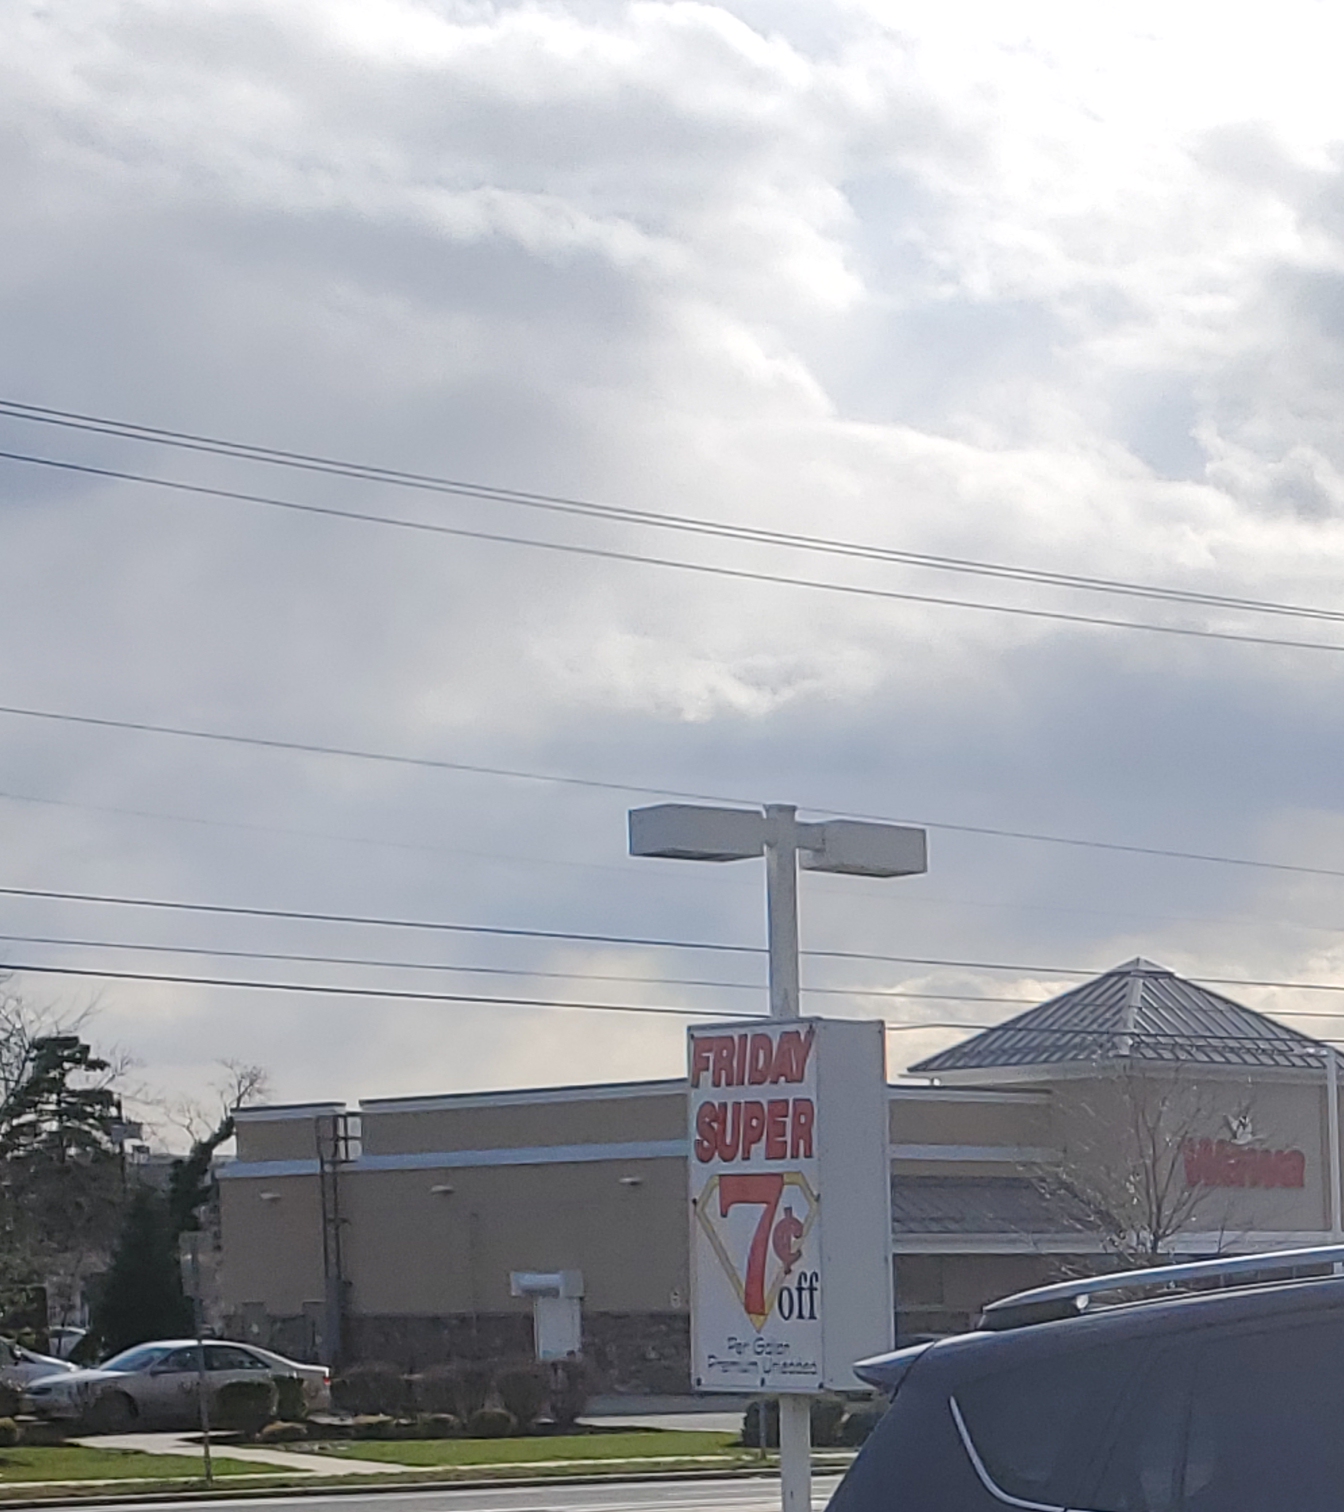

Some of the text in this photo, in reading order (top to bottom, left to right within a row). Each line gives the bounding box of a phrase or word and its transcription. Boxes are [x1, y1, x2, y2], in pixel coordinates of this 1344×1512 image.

[690, 1030, 816, 1088] FRIDAY
[693, 1098, 815, 1163] SUPER
[777, 1272, 819, 1321] off
